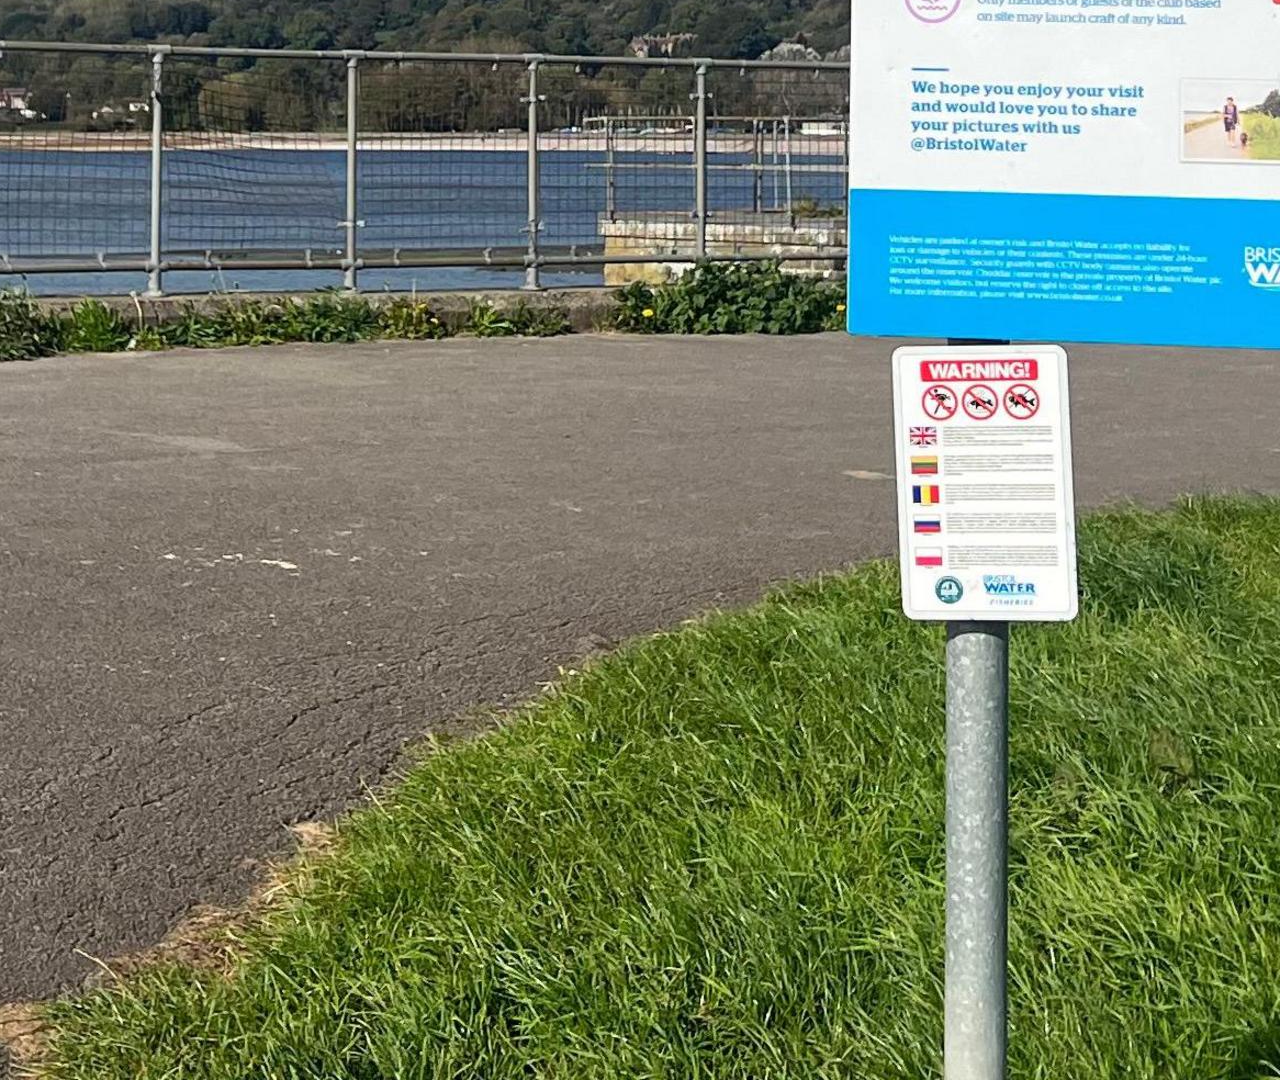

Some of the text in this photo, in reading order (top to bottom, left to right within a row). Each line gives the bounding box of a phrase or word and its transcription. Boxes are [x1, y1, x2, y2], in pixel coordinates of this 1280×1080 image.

[911, 80, 1144, 98] We hope you enjoy your visit
[911, 99, 1136, 117] and would love you to share
[910, 119, 1080, 134] your pictures with us
[911, 138, 1027, 152] @BristolWater
[928, 361, 1030, 379] WARNING!
[983, 583, 1035, 593] WATER
